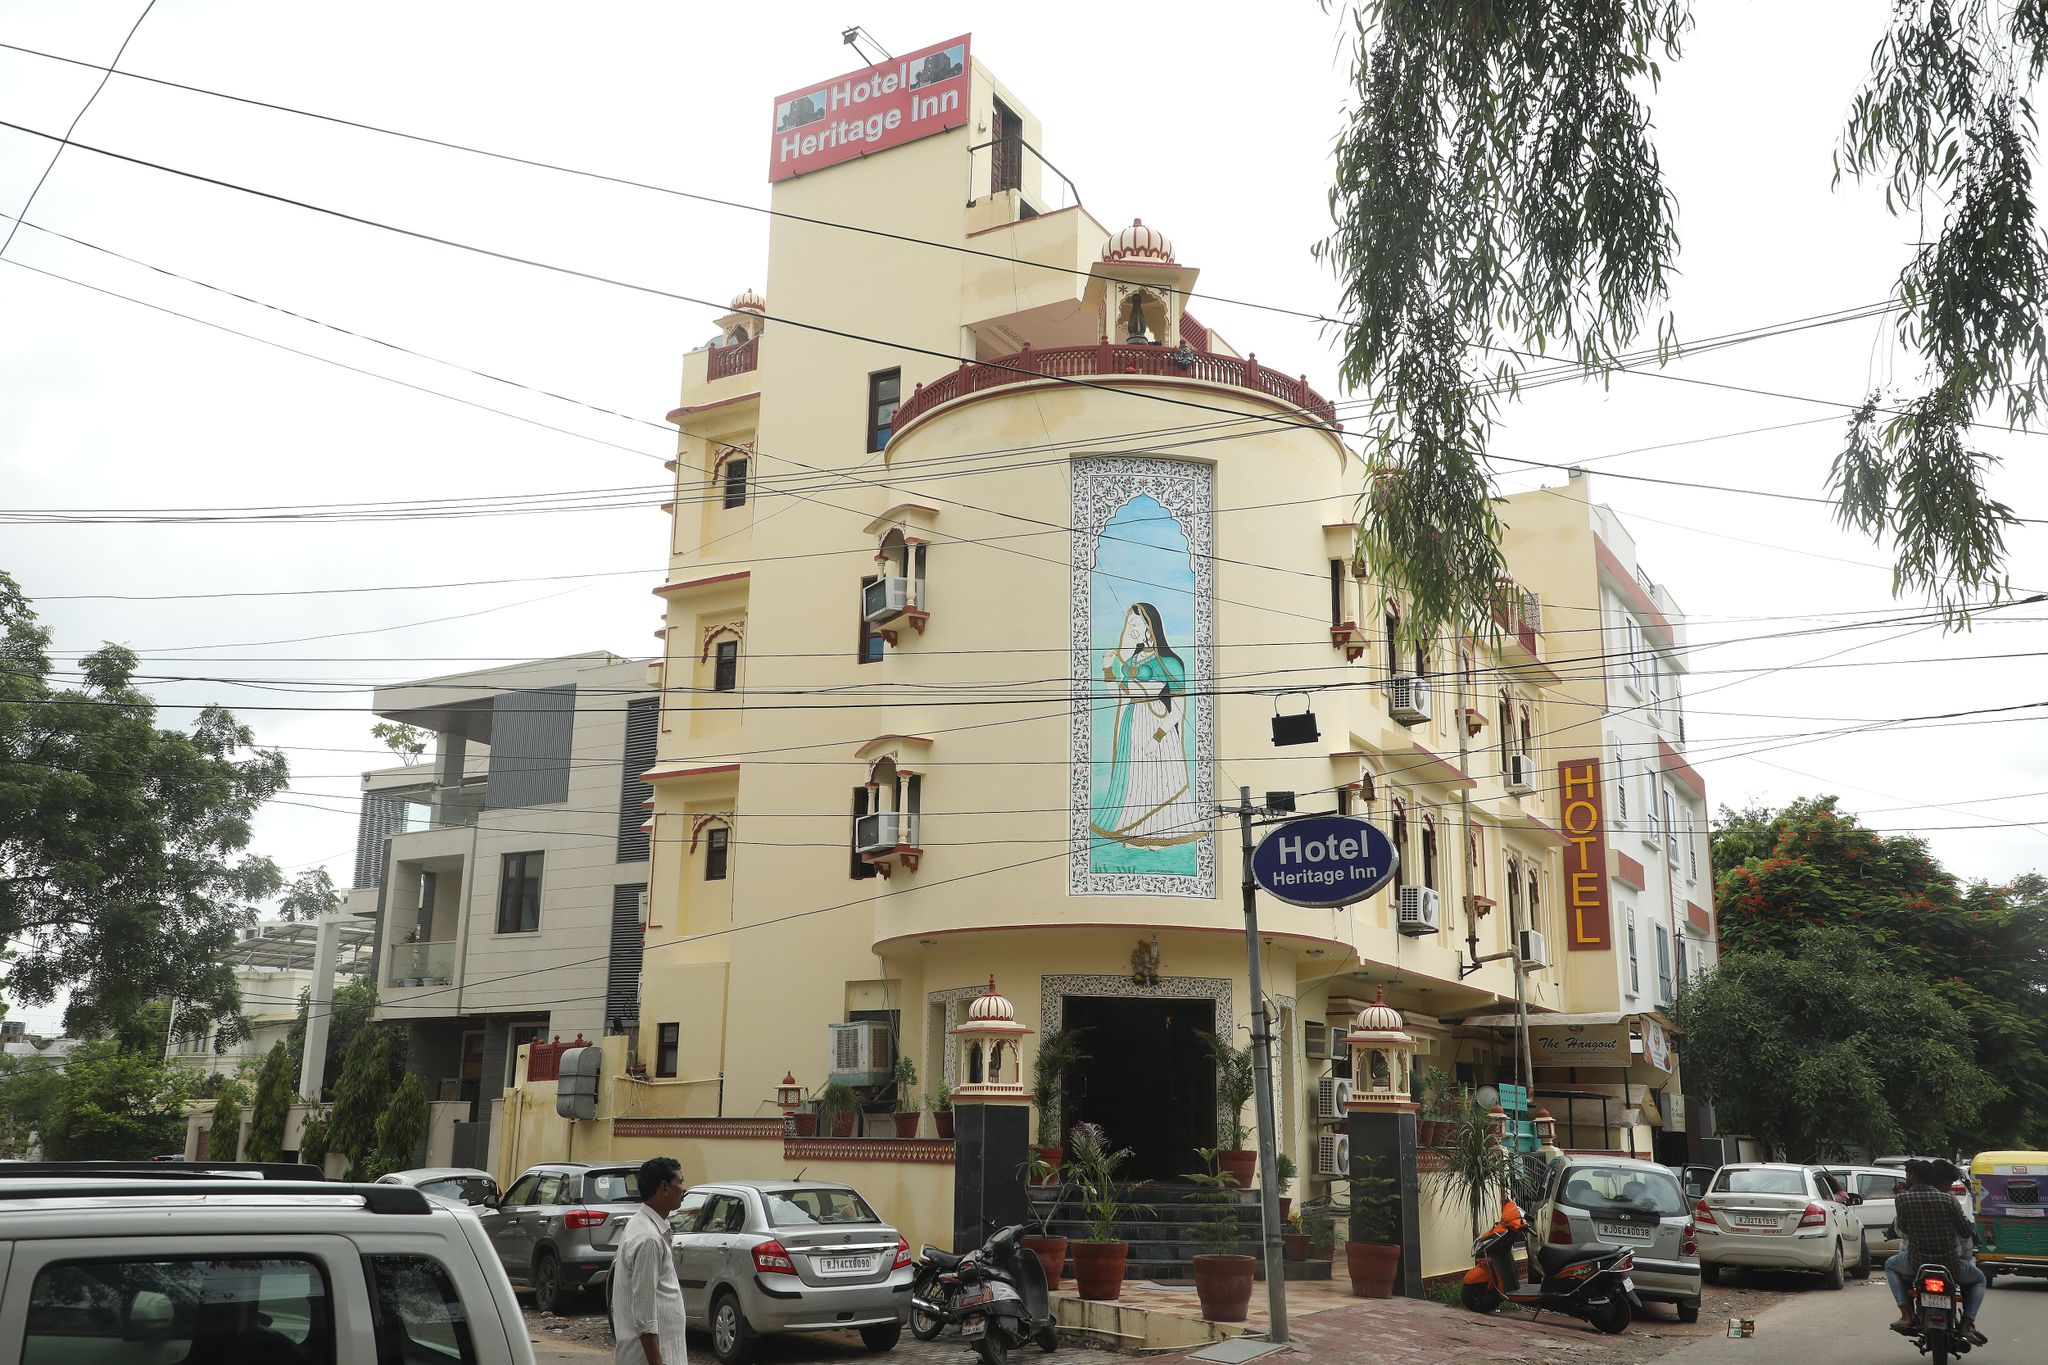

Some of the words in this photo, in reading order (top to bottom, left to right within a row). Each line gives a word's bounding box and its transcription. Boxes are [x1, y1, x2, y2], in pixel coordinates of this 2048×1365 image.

[830, 62, 907, 111] Hotel
[779, 107, 902, 163] Heritage
[911, 88, 959, 123] Inn
[1279, 829, 1369, 865] Hotel
[1564, 764, 1600, 943] HOTEL
[1273, 869, 1345, 886] Heritage
[1350, 865, 1377, 880] Inn
[1538, 1036, 1560, 1049] The
[1565, 1036, 1618, 1052] Hangout
[1603, 1225, 1650, 1237] RJ06CA0038
[826, 1258, 870, 1270] RJ14CX8090
